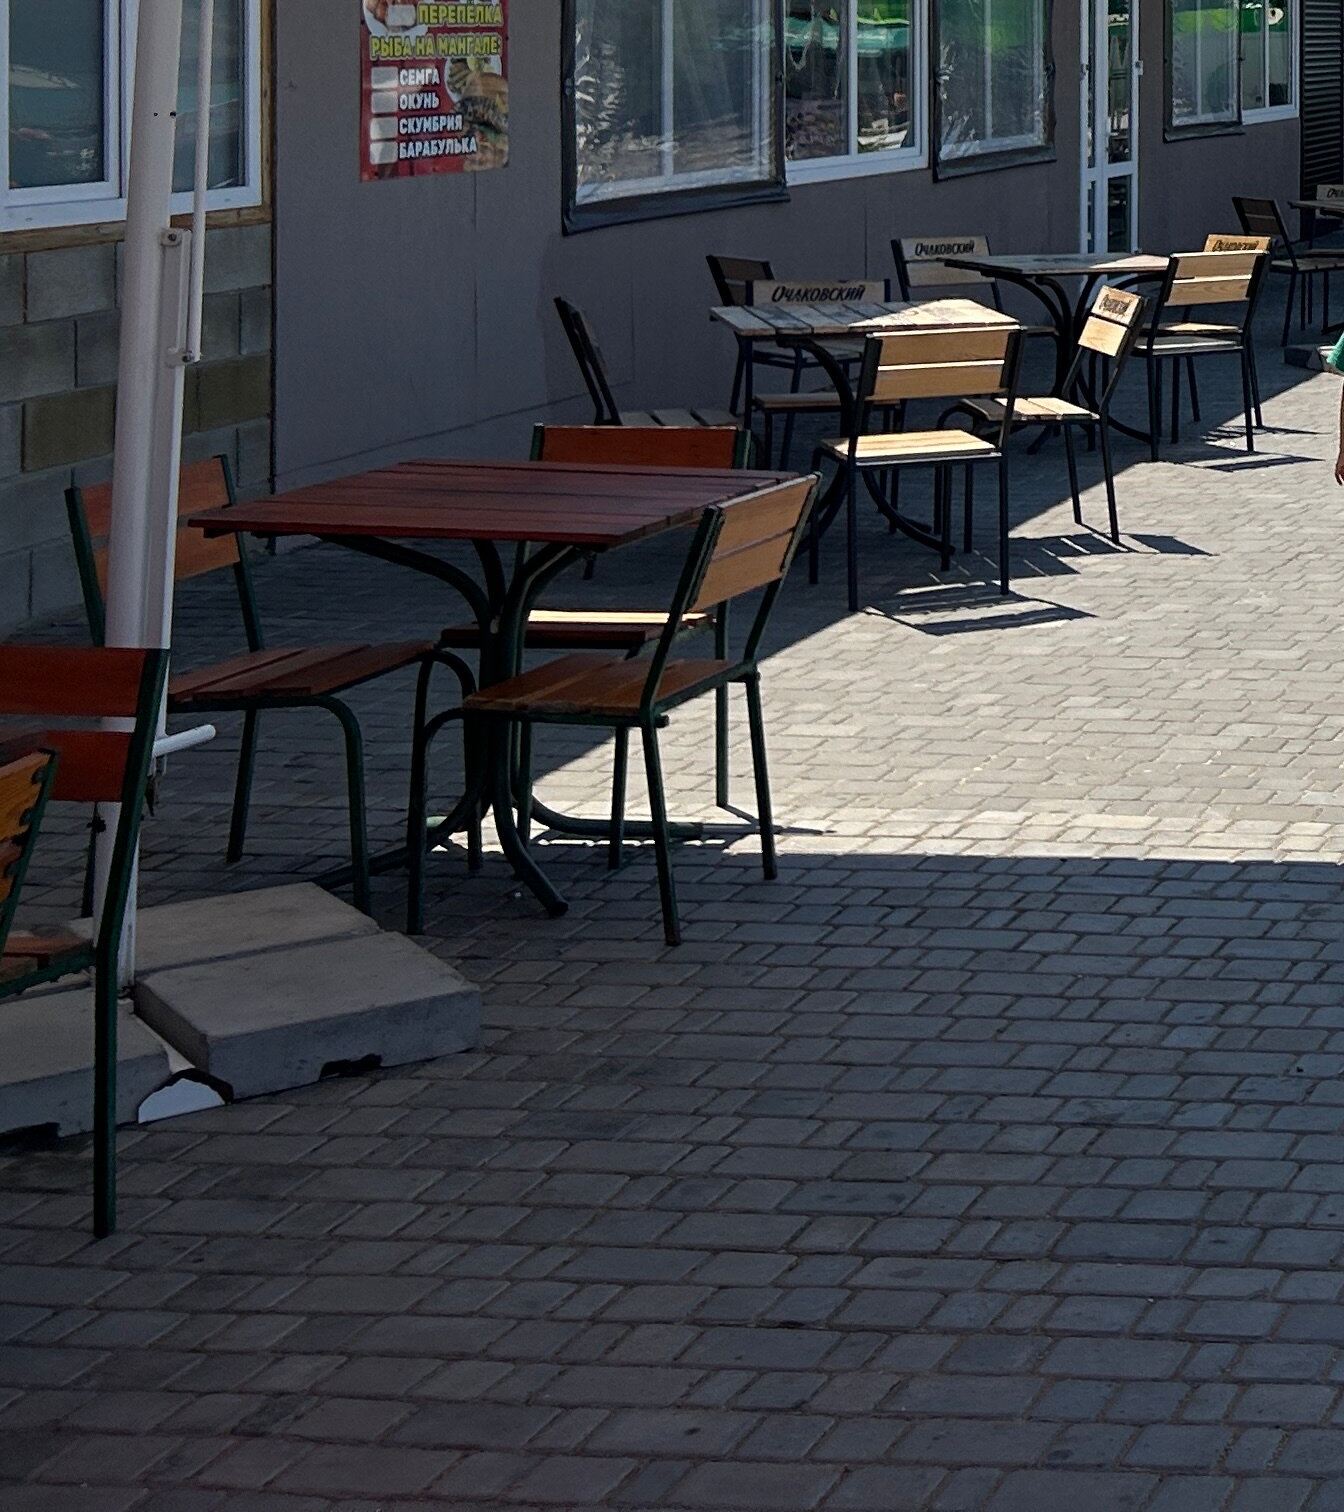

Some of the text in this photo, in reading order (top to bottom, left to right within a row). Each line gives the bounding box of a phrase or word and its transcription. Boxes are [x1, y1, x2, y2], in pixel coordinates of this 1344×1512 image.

[418, 0, 501, 25] ПЕРЕПЁЛКА
[371, 36, 412, 57] РЫБА
[416, 37, 435, 56] НА
[399, 67, 440, 85] СЕМГА
[399, 92, 440, 110] ОКУНЬ
[399, 114, 463, 135] СКУМБРИЯ
[399, 136, 477, 159] БАРАБУЛЬКА
